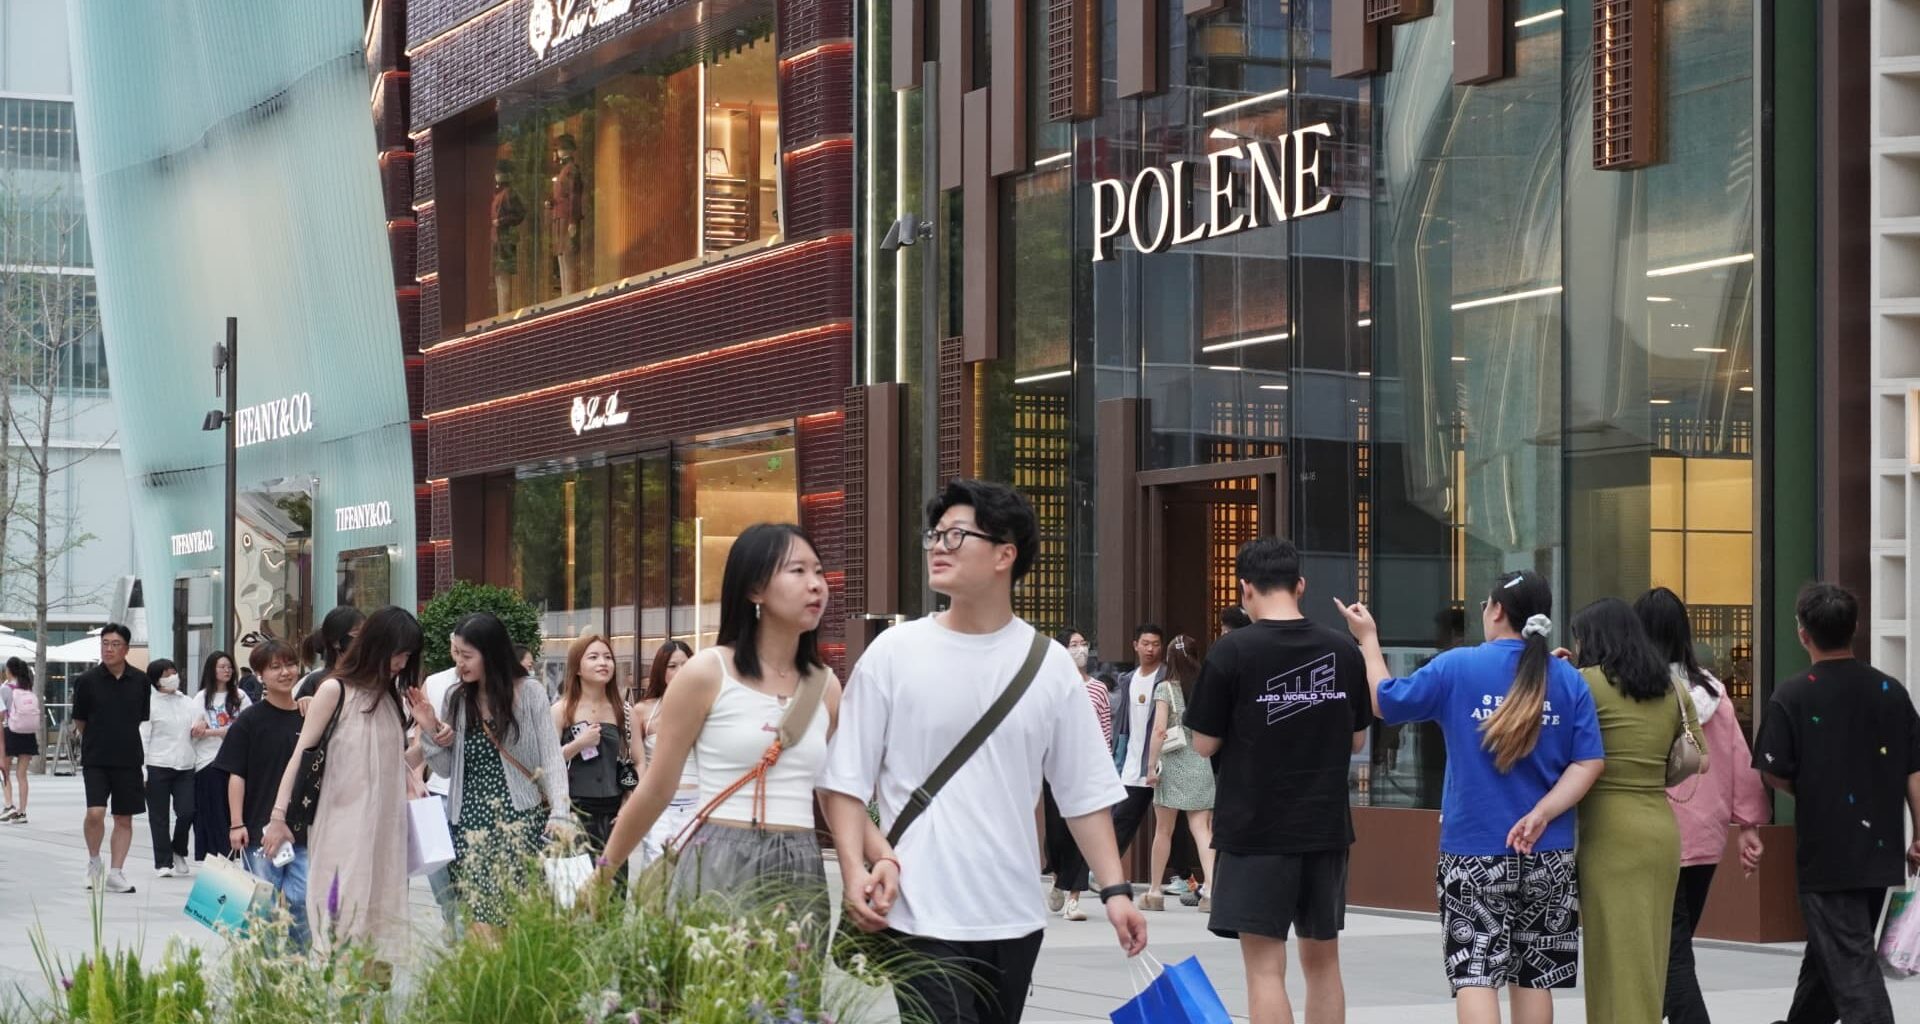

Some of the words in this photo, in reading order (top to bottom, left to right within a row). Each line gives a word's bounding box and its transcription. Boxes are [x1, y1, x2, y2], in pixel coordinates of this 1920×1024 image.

[1091, 122, 1332, 262] POLÈNE
[235, 392, 312, 448] IFFANY&CO.
[1282, 692, 1318, 701] WORLD
[1320, 691, 1347, 700] TOUR
